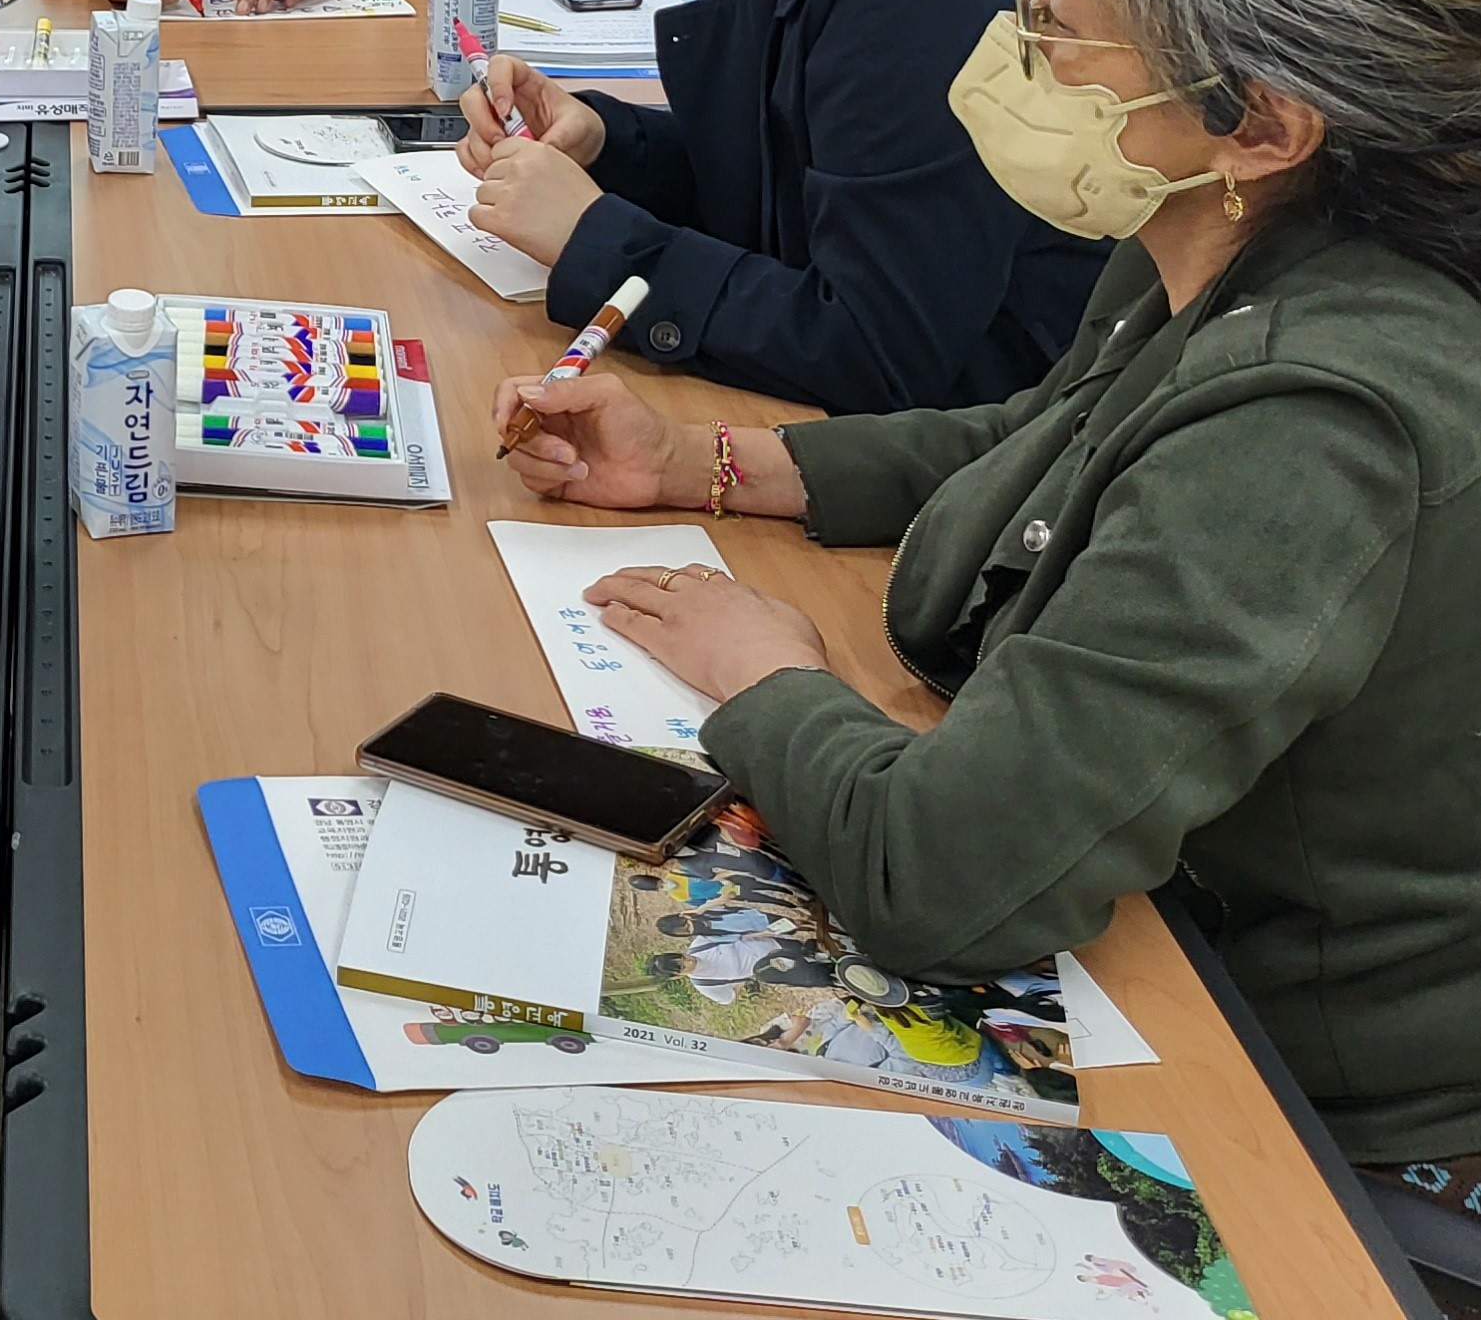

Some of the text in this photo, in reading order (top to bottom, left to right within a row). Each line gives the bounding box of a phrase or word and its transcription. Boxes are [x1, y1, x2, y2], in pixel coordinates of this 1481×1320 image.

[124, 381, 153, 503] 자연드림
[111, 446, 120, 494] JUST
[623, 1026, 708, 1053] 2021 Vol. 32
